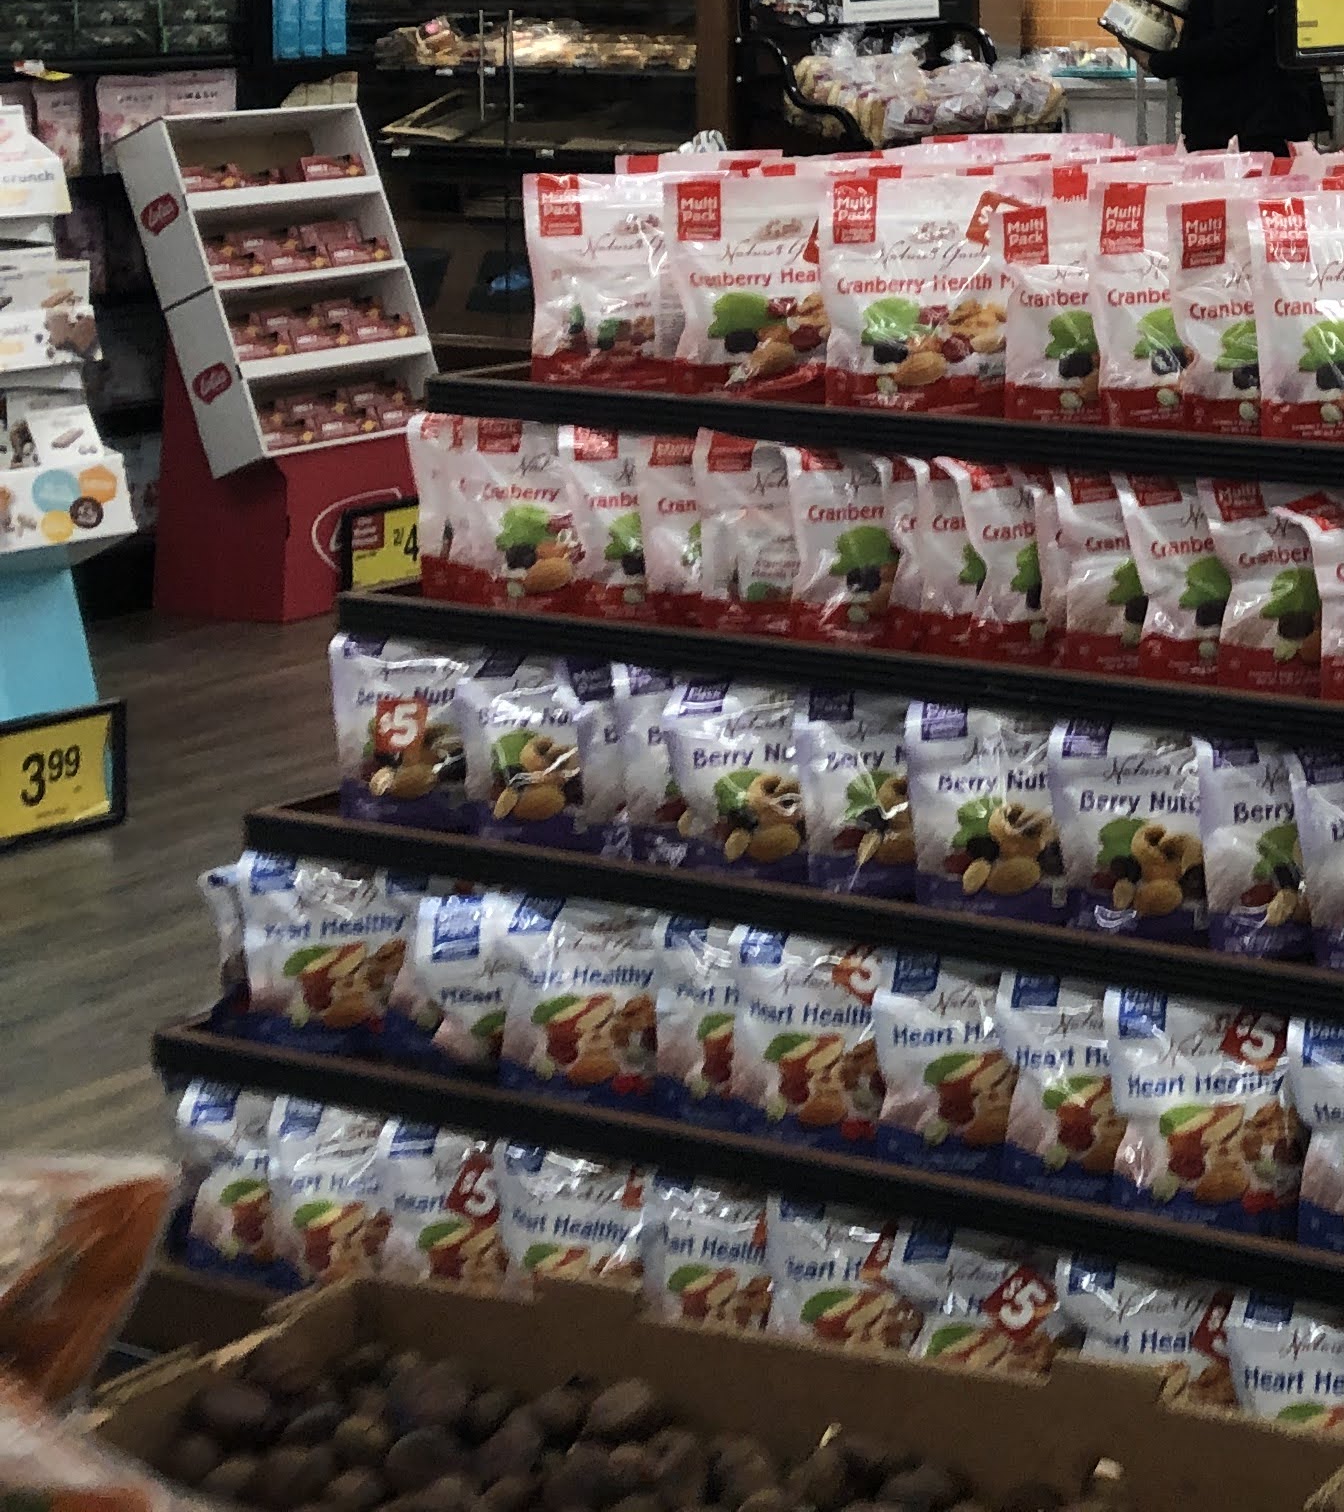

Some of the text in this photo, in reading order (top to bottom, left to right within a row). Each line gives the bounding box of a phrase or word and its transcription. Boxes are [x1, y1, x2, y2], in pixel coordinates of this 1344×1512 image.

[680, 195, 719, 210] Multi
[836, 193, 874, 211] Multi
[682, 208, 717, 224] Pack
[837, 207, 873, 223] Pack
[1104, 204, 1142, 221] Multi
[1006, 218, 1045, 235] Multi
[1104, 217, 1141, 233] Pack
[1185, 218, 1224, 236] Multi
[1008, 231, 1045, 247] Pack
[1187, 232, 1222, 248] Pack
[836, 274, 925, 296] Cranberry
[691, 748, 754, 769] Berry
[937, 774, 999, 794] Berry
[1078, 789, 1141, 814] Berry
[1232, 800, 1296, 824] Berry
[892, 1021, 955, 1046] Heart
[1015, 1044, 1076, 1069] Heart
[1127, 1073, 1186, 1098] Heart
[1244, 1365, 1306, 1394] Heart
